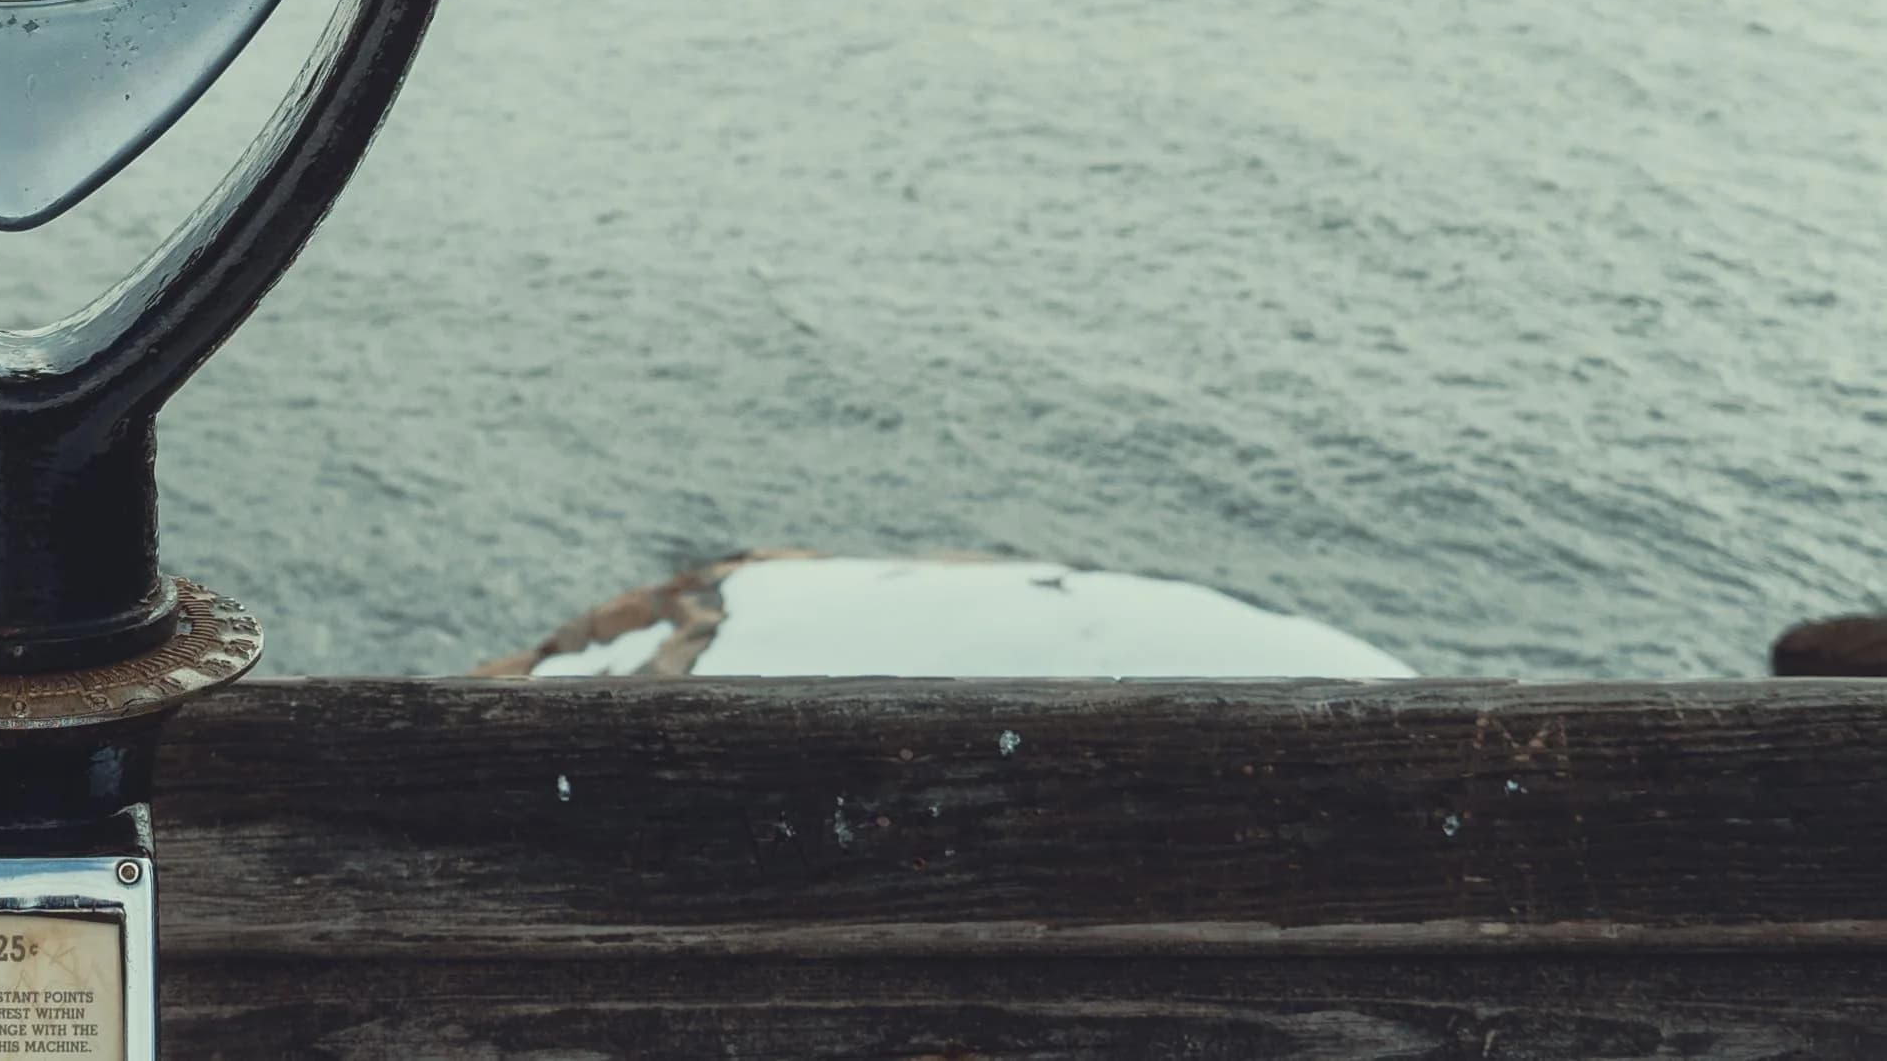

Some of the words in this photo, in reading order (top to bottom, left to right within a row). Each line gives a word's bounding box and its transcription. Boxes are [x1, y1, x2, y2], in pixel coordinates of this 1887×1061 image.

[44, 991, 94, 1003] POINTS
[35, 1007, 85, 1019] WITHIN
[32, 1024, 67, 1036] WITH
[72, 1024, 98, 1036] THE
[24, 1040, 92, 1053] MACHINE.
